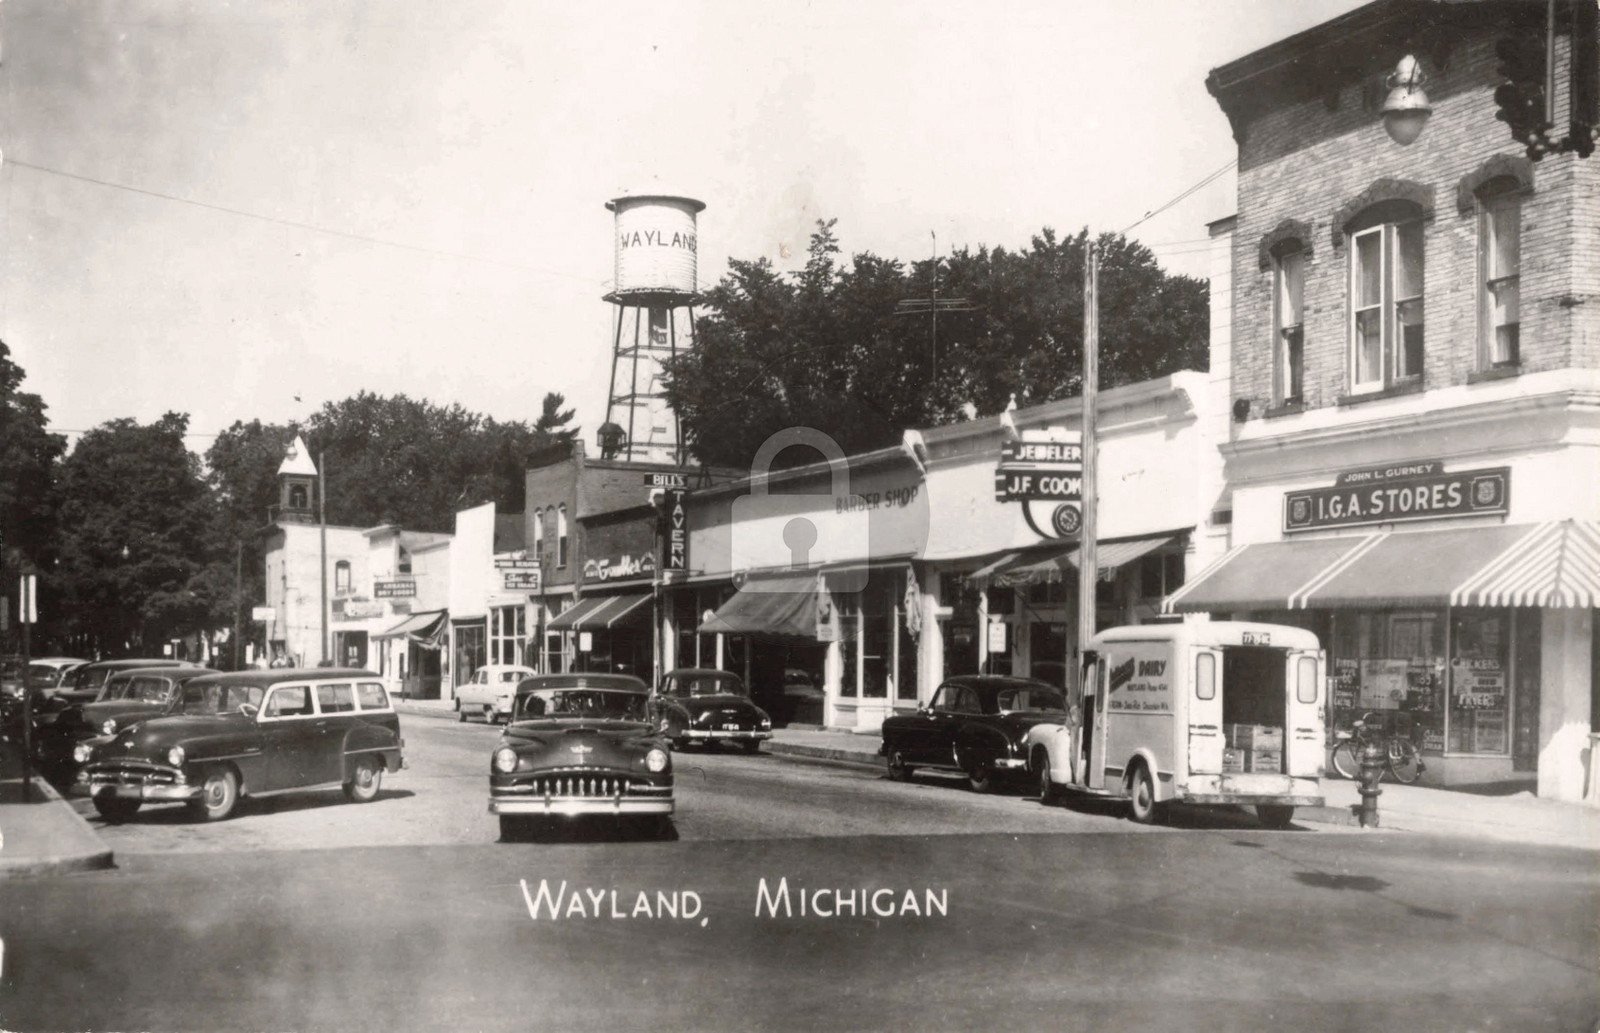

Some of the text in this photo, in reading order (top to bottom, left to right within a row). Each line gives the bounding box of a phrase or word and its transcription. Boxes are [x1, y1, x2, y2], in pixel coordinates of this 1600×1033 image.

[620, 230, 697, 251] WAYLAND
[653, 473, 685, 486] BILL'S
[1344, 471, 1371, 482] JOHN
[1386, 464, 1434, 478] GURNEY
[1007, 476, 1035, 493] J.F.
[836, 485, 919, 514] BARBER SHOP
[1318, 482, 1463, 520] I.G.A. STORES
[671, 490, 685, 568] TAVERN
[1138, 660, 1167, 677] DAIRY
